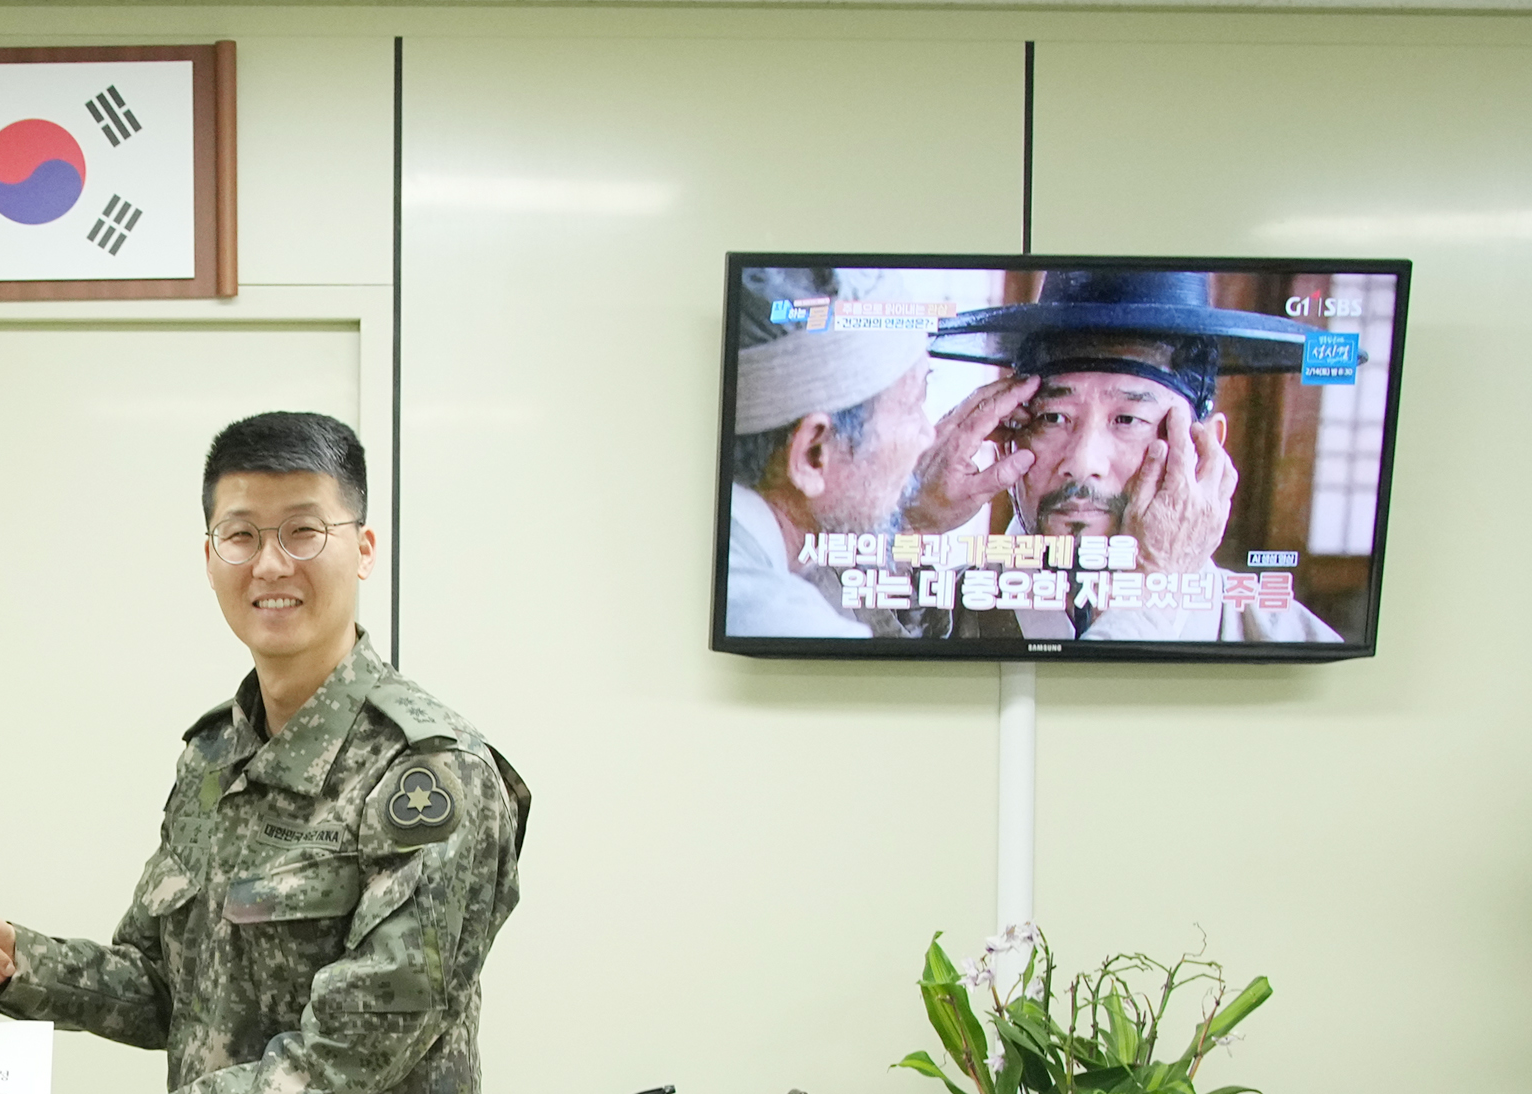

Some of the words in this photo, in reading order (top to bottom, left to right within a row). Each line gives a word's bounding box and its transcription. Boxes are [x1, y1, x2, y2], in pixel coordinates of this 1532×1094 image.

[842, 303, 883, 315] 주름으로
[885, 303, 926, 316] 읽어내는
[927, 303, 949, 316] 관상
[1324, 297, 1362, 317] SBS
[842, 318, 882, 329] 건강과의
[884, 318, 930, 330] 연관성은?
[798, 533, 884, 567] 사람의
[958, 535, 1074, 569] 가족관계
[1078, 536, 1139, 570] 등을
[841, 568, 913, 609] 읽는
[918, 570, 955, 610] 데
[962, 570, 1069, 611] 중요한
[1074, 571, 1214, 610] 자료였던
[1221, 572, 1294, 612] 주름
[1027, 643, 1062, 652] SAMSUNG
